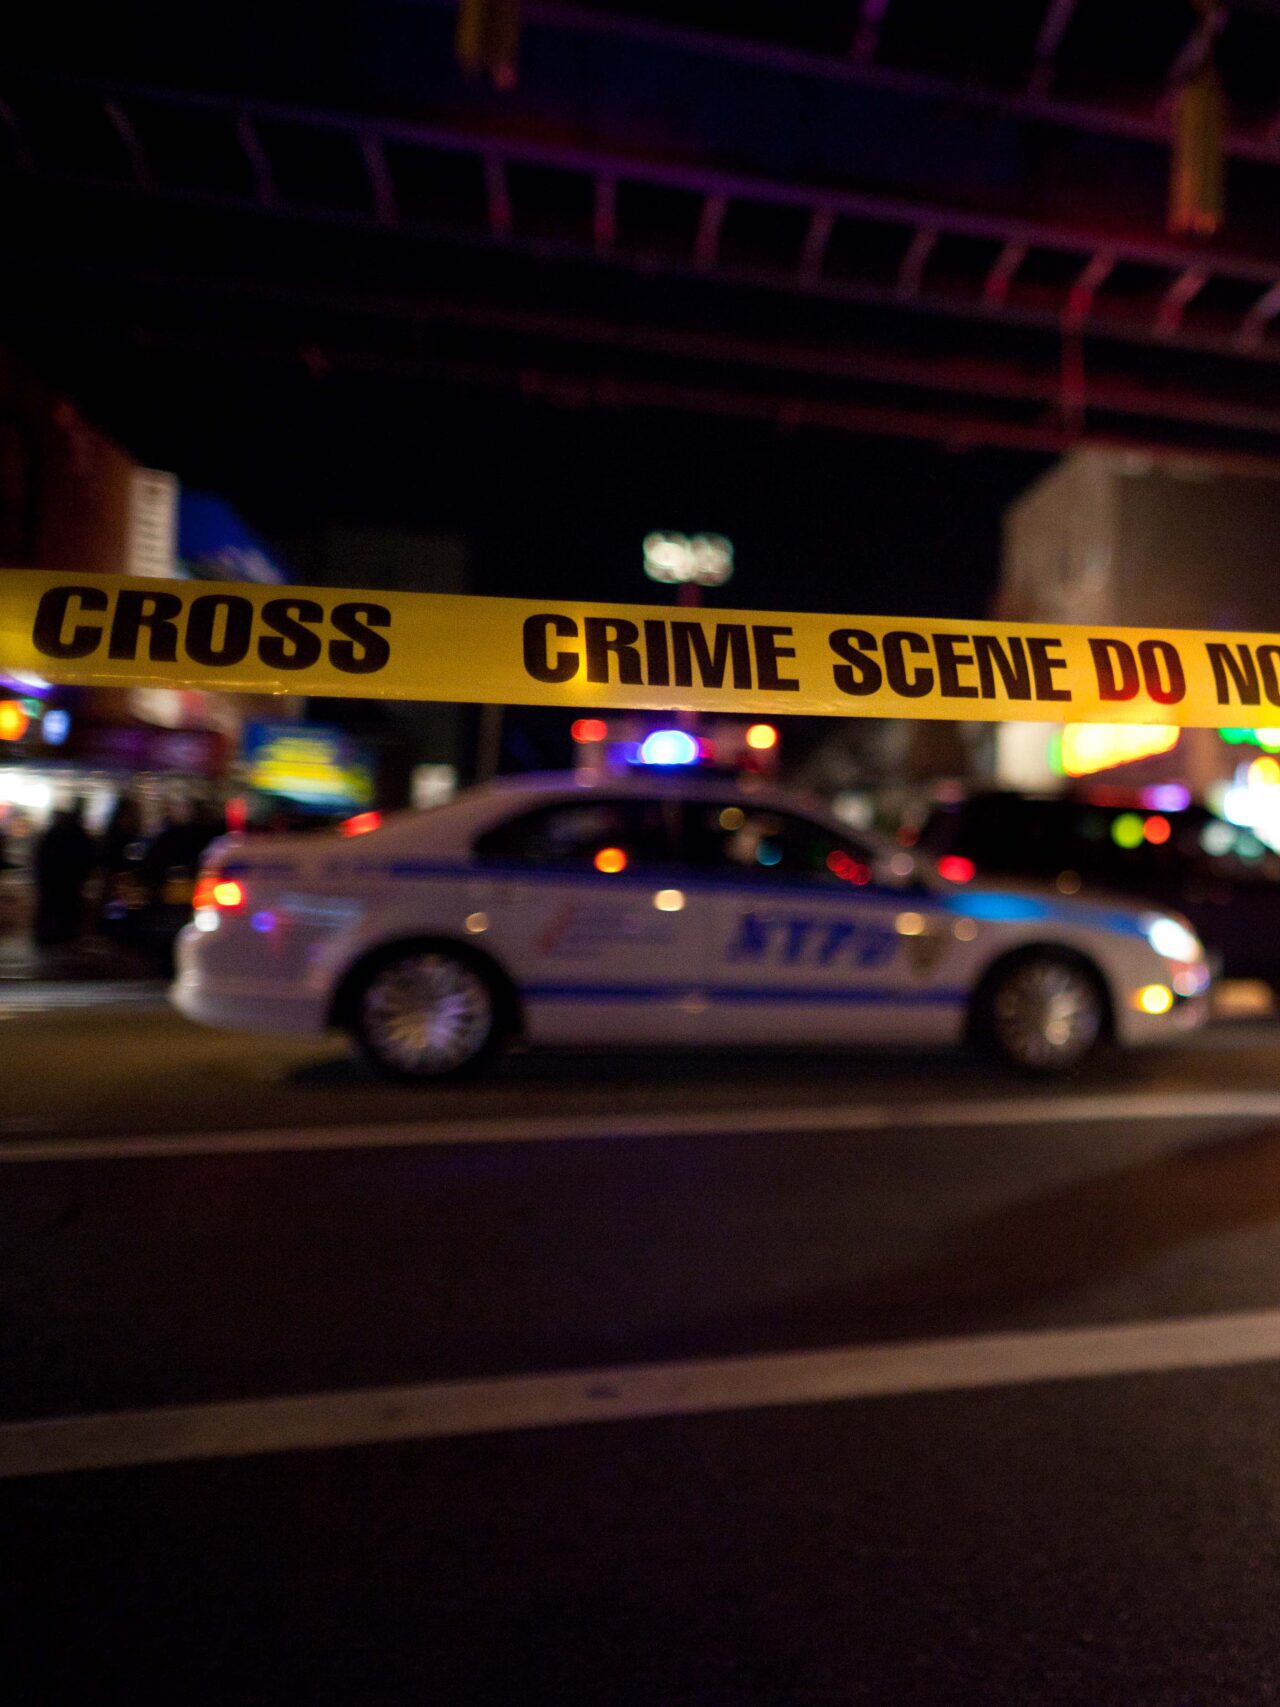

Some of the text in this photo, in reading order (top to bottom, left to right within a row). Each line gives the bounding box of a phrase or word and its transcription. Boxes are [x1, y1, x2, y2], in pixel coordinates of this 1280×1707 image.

[32, 586, 391, 674] CROSS
[522, 613, 800, 692] CRIME
[828, 628, 1072, 702] SCENE
[1087, 637, 1186, 705] DO
